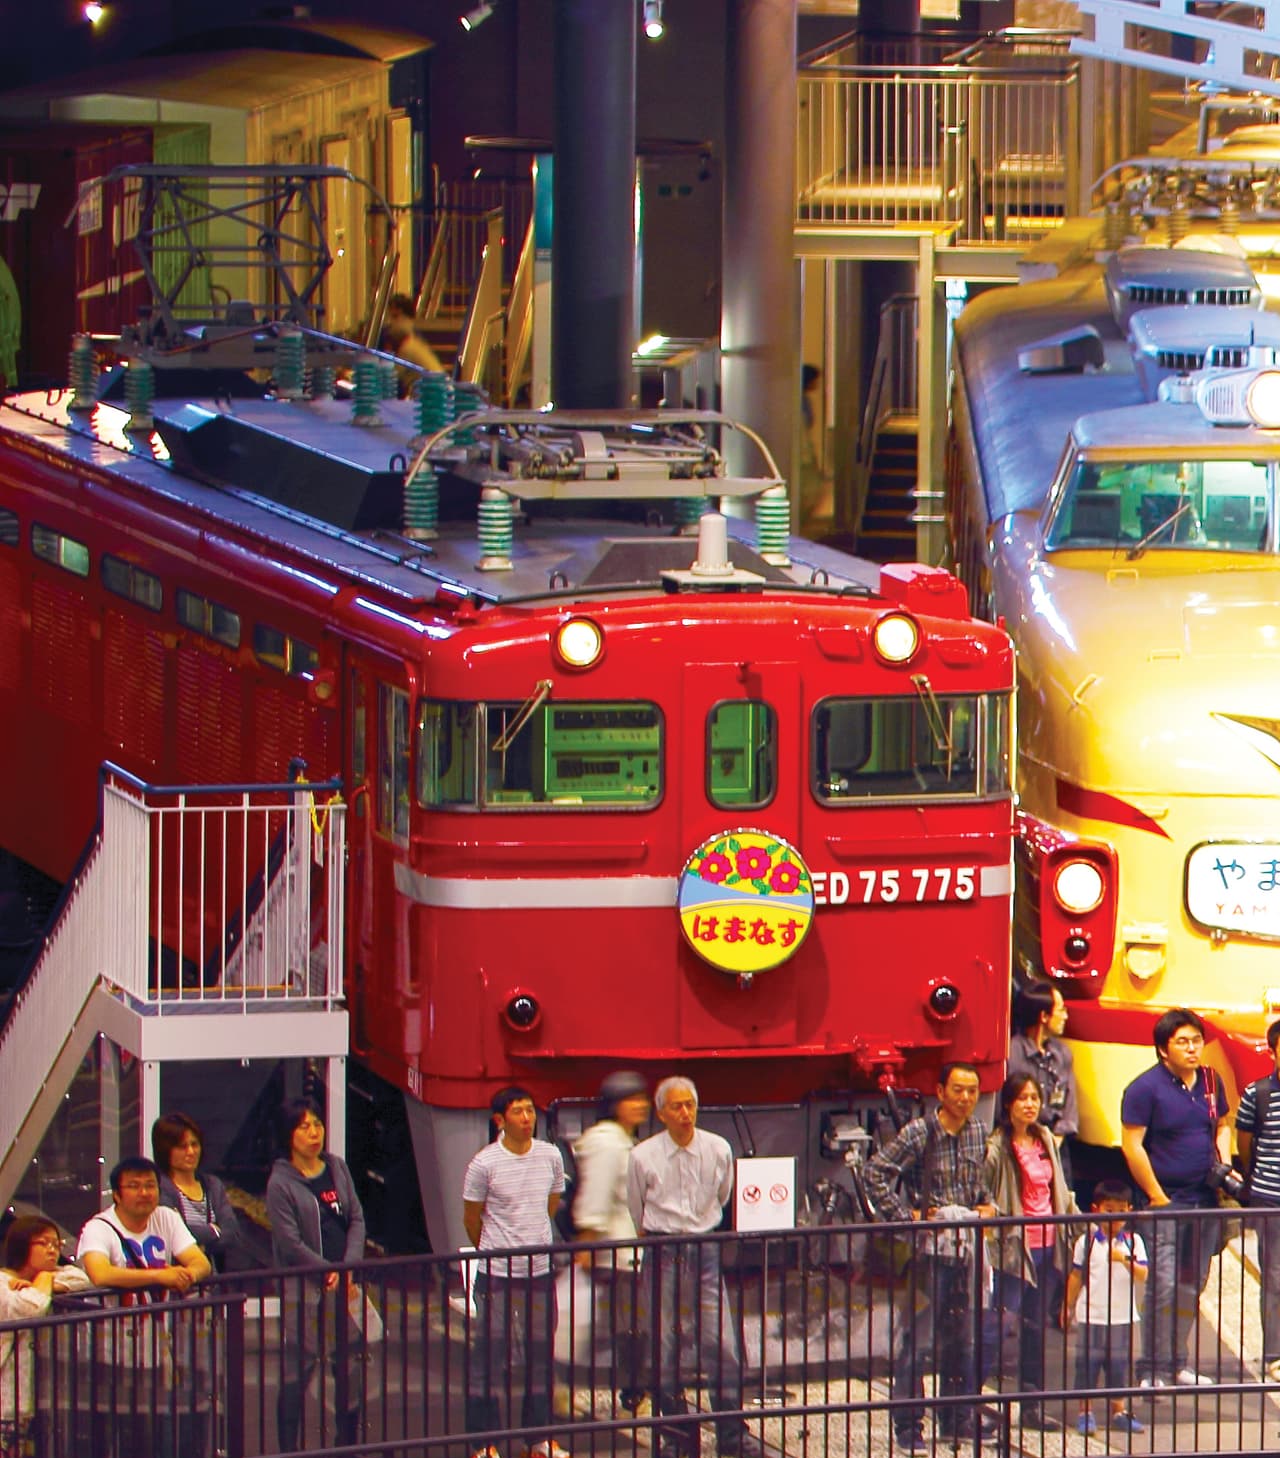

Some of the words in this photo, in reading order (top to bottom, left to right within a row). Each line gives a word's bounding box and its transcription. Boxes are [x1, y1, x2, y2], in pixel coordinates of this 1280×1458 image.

[814, 871, 850, 905] ED
[858, 869, 900, 904] 75
[911, 867, 976, 902] 775
[692, 914, 804, 949] はまなす
